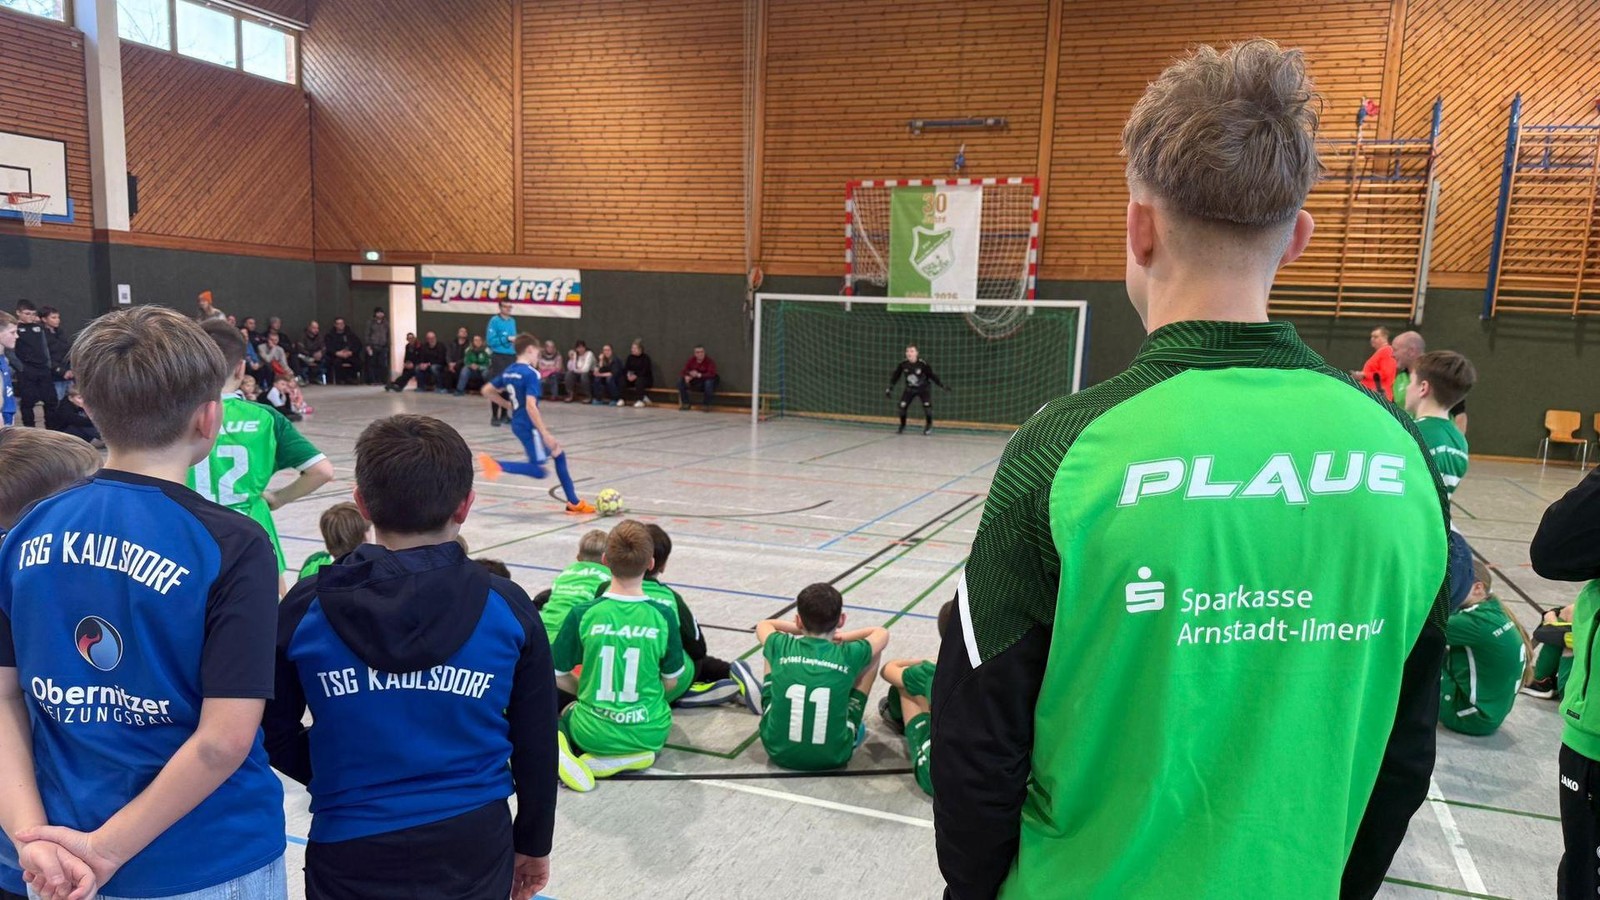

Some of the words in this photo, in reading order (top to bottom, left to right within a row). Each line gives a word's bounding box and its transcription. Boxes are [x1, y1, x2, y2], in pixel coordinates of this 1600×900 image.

[921, 192, 948, 214] 30
[431, 276, 575, 303] sport-treff
[194, 444, 249, 506] 12
[1116, 451, 1406, 508] PLAUE
[19, 533, 53, 571] TSG
[62, 531, 190, 595] KAULSDORF
[1181, 585, 1313, 616] Sparkasse
[590, 623, 660, 640] PLAUE
[1177, 617, 1385, 646] Arnstadt-Ilmenu
[317, 667, 359, 698] TSG
[367, 664, 494, 699] KAULSDORF
[596, 645, 640, 703] 11
[31, 676, 170, 715] Obernitzer
[785, 683, 831, 745] 11
[1560, 774, 1580, 792] JAKO
